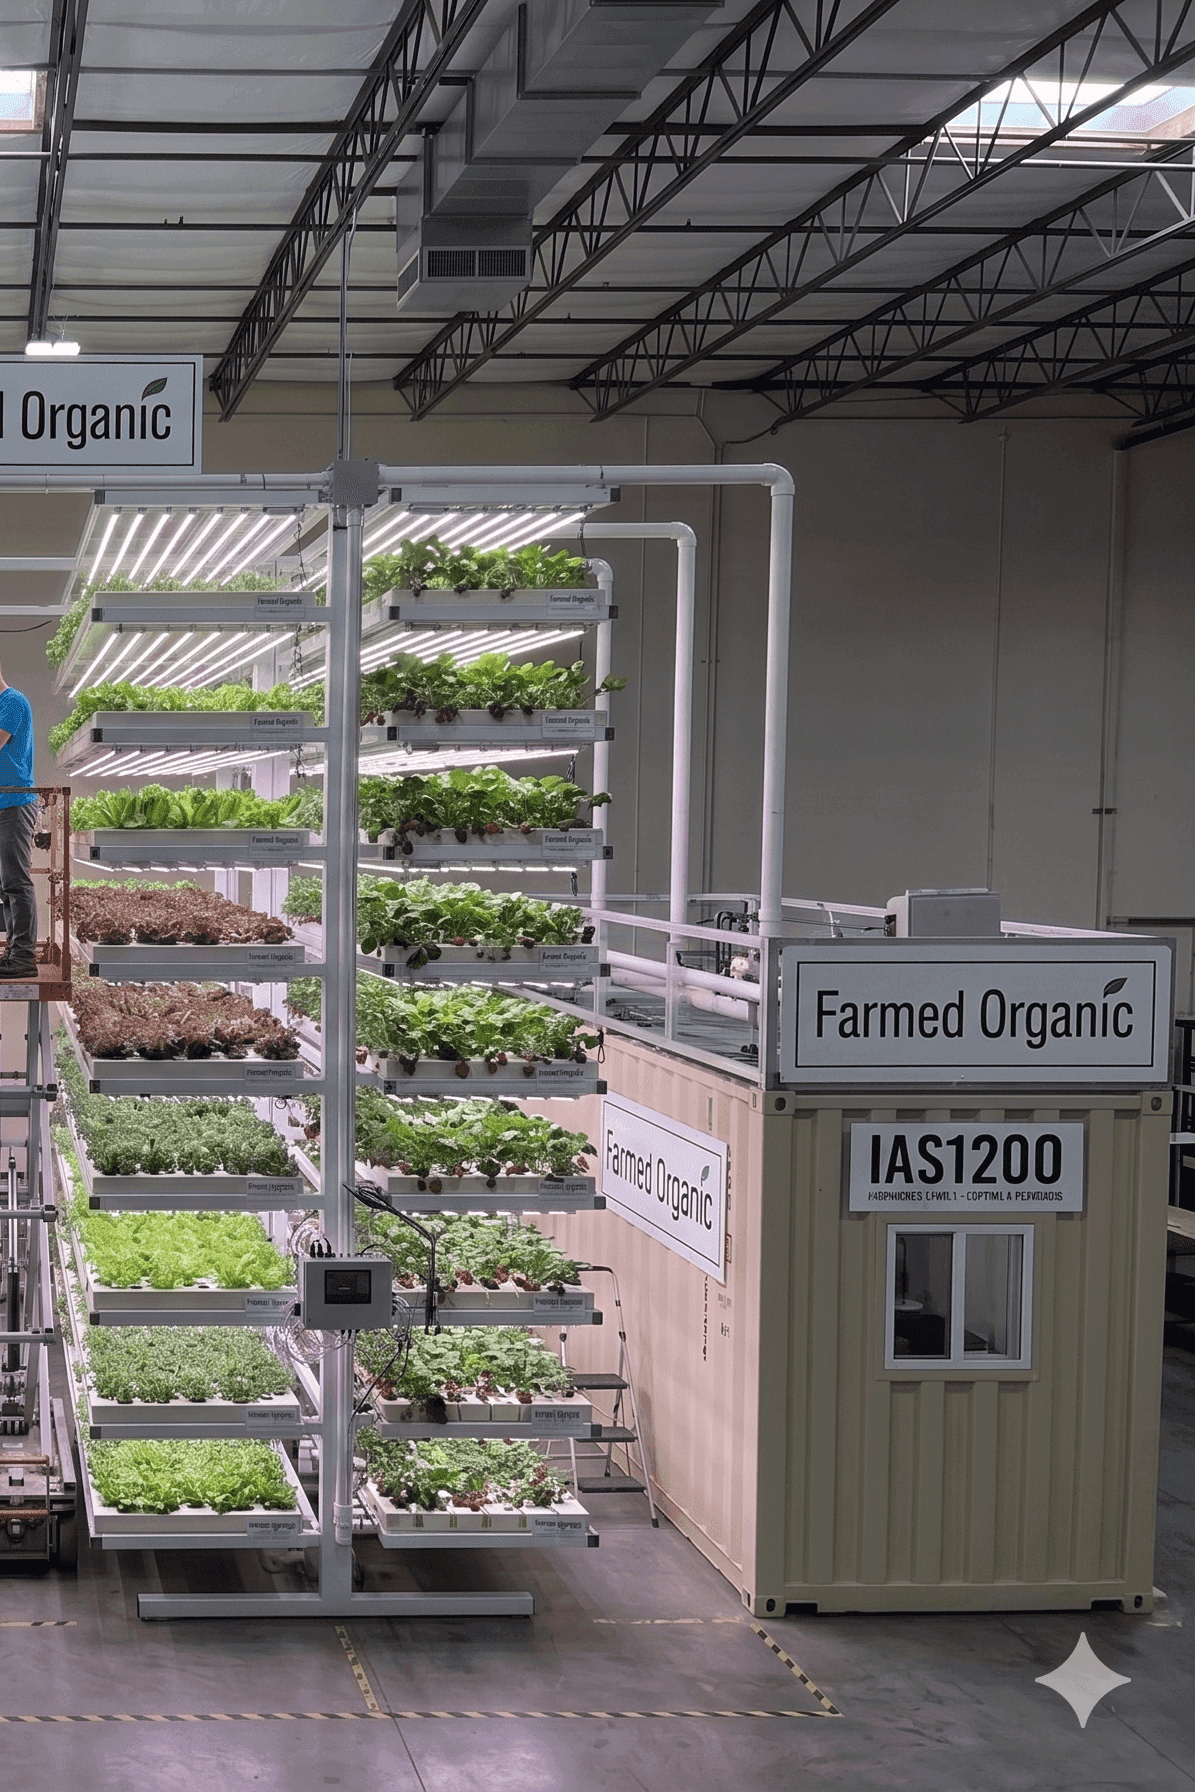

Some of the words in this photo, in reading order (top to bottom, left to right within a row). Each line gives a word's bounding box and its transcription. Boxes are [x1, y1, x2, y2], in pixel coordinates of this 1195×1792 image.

[20, 389, 172, 450] Organic
[815, 989, 965, 1039] Farmed
[979, 988, 1134, 1049] Organic
[606, 1129, 652, 1195] Farmed
[656, 1157, 713, 1231] Organic
[870, 1133, 1062, 1185] IAS1200
